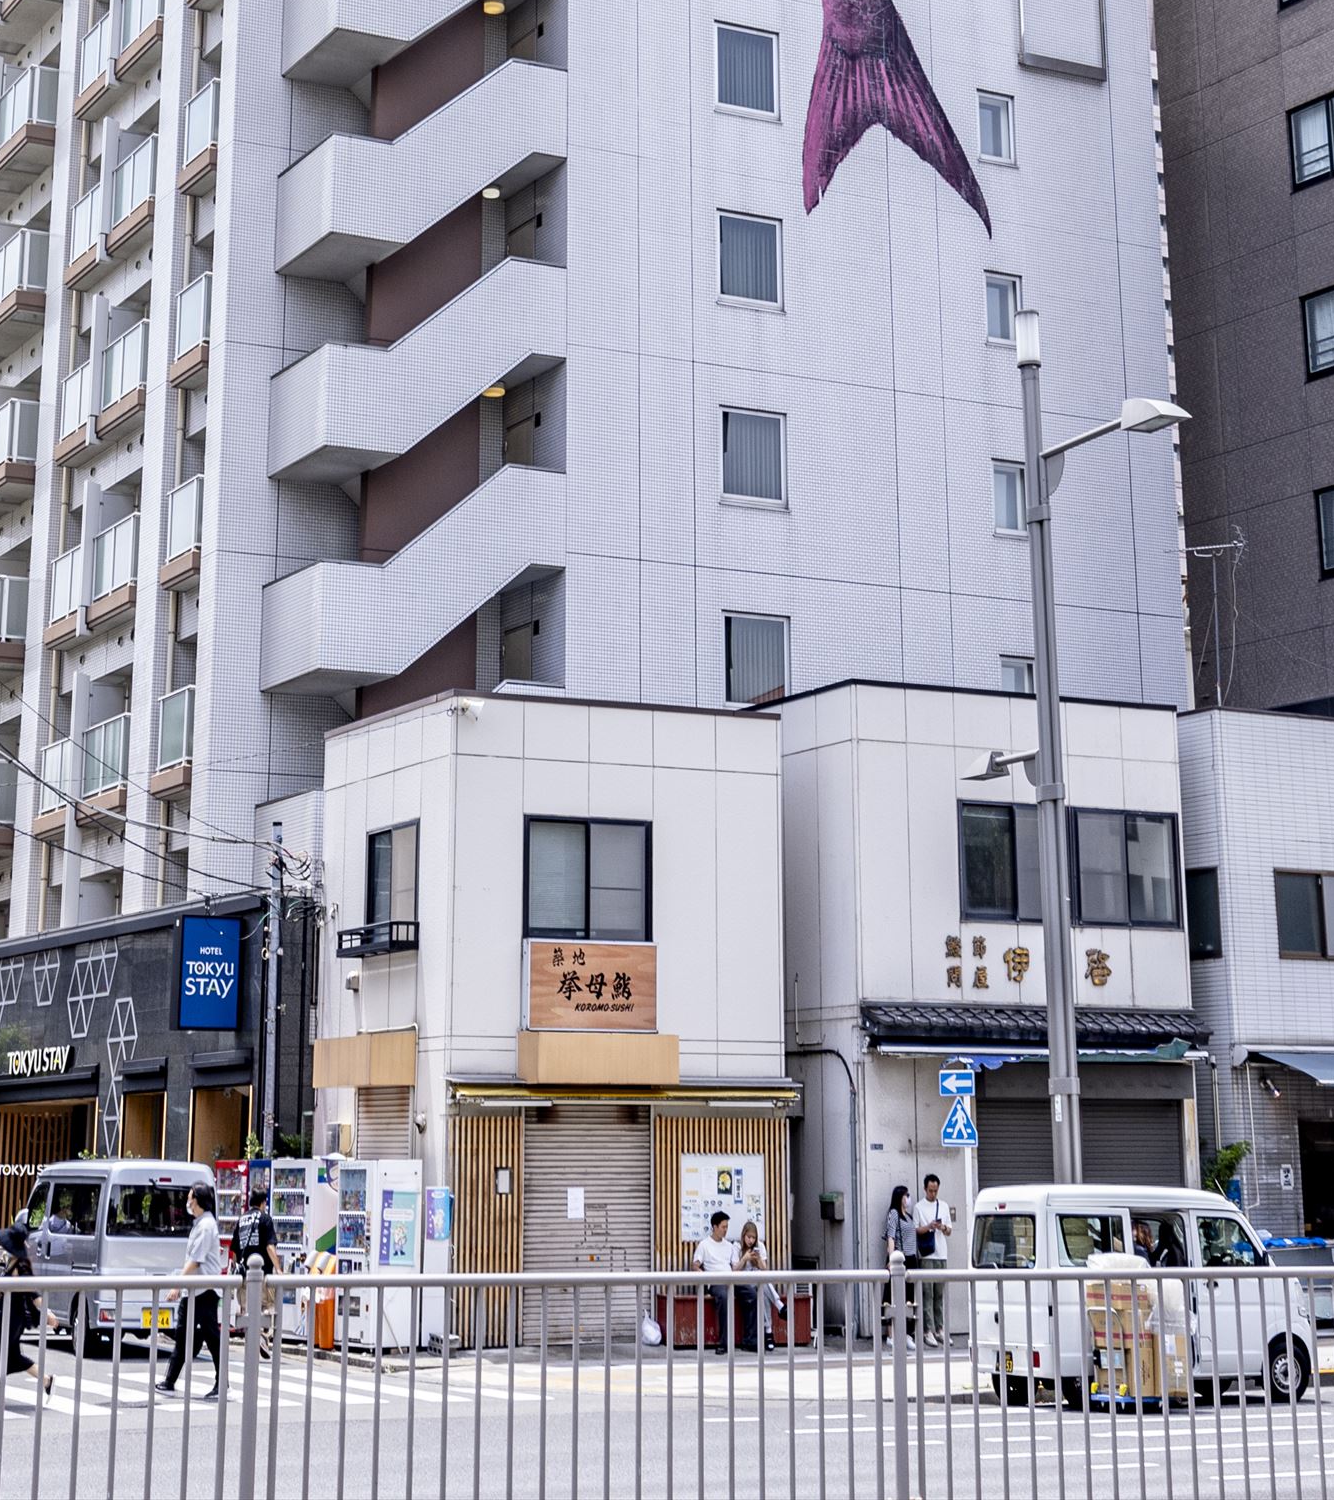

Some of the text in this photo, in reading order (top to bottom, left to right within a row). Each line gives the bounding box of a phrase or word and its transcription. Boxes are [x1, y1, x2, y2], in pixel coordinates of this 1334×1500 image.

[200, 946, 223, 956] HOTEL
[552, 947, 586, 967] 築地
[186, 961, 234, 977] TOKYU
[185, 977, 234, 999] STAY
[7, 1045, 71, 1077] TOKYU STAY
